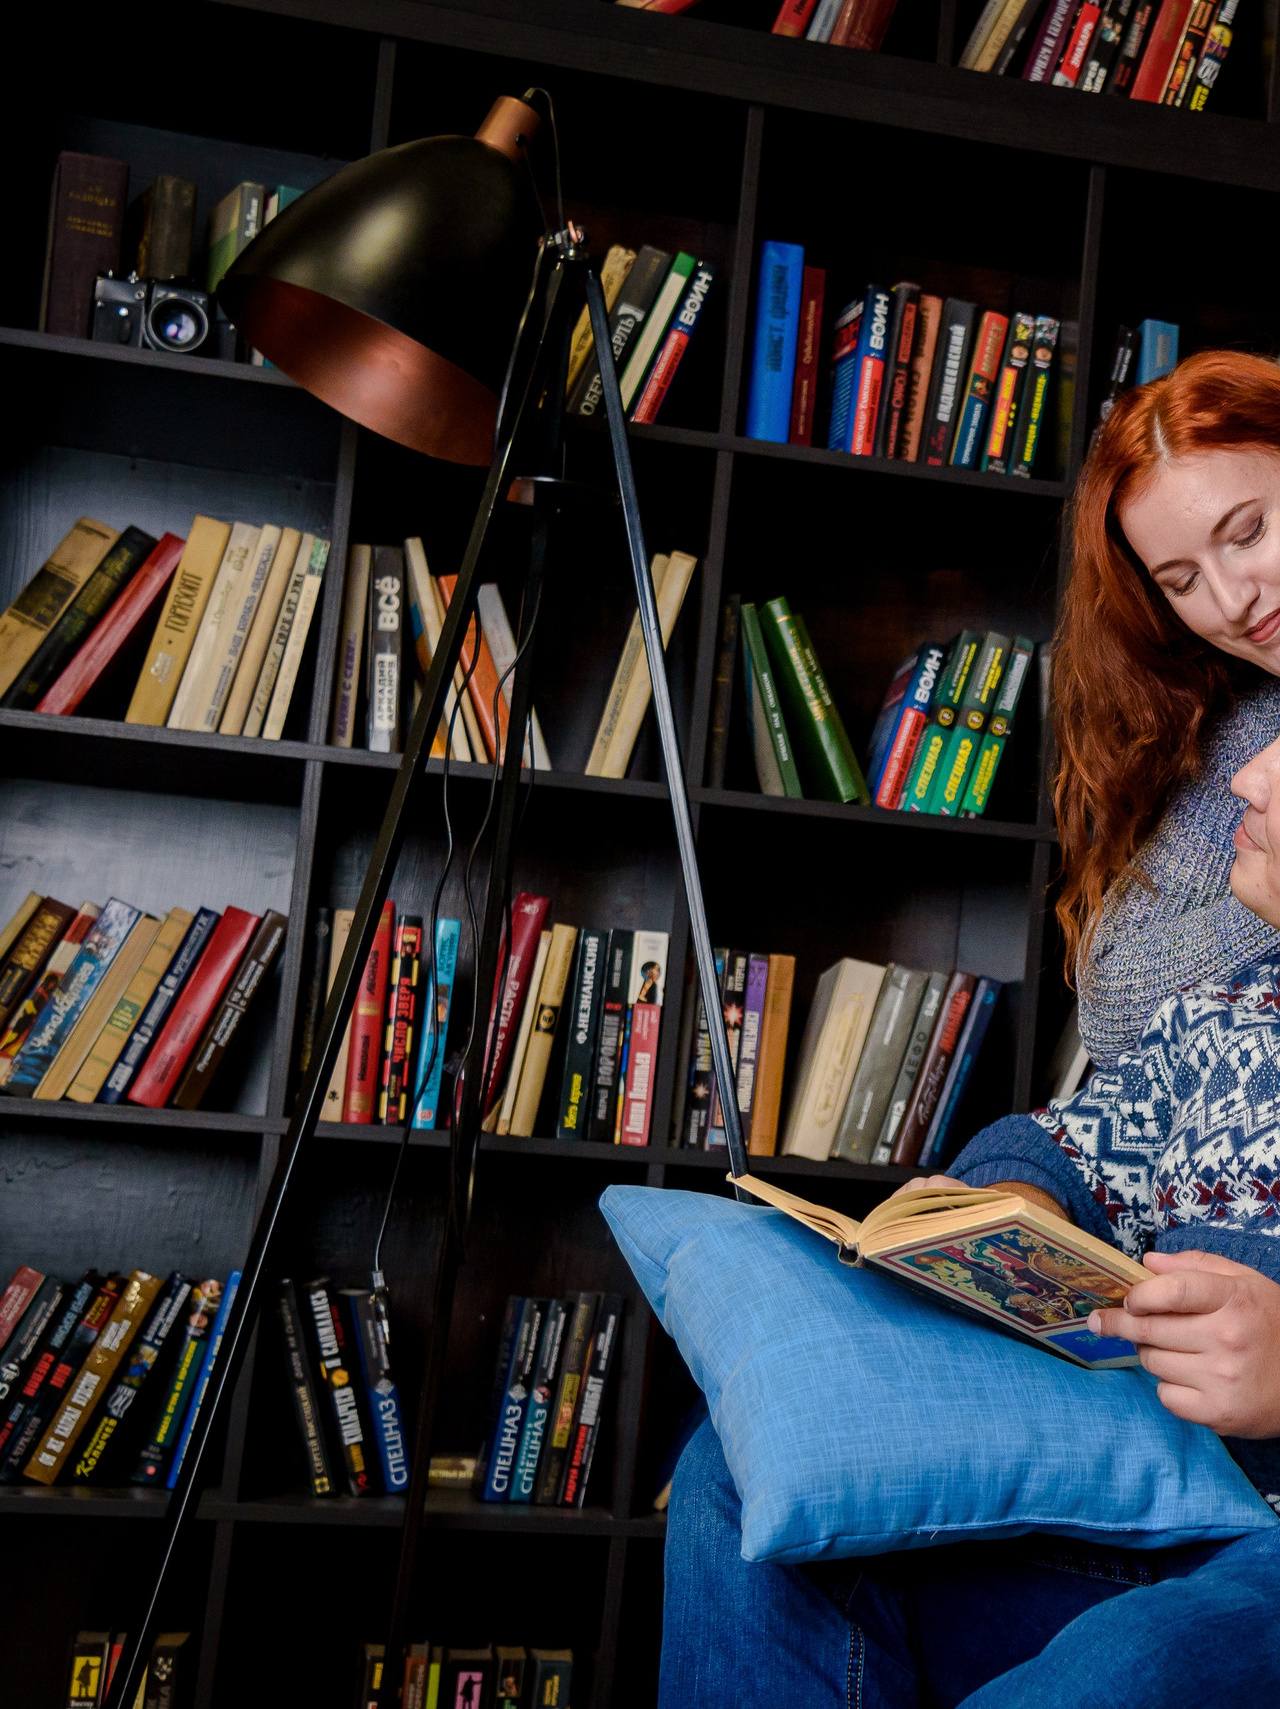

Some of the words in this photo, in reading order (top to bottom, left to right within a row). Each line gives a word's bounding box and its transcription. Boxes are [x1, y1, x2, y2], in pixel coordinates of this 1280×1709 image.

[678, 270, 714, 327] ВОИН
[869, 292, 890, 351] ВОИН
[164, 569, 203, 635] ГОРИЗОНТ
[376, 659, 385, 723] АРКАДИЙ
[386, 661, 396, 722] АРКАНОВ
[914, 648, 943, 703] ВОИН
[914, 735, 943, 799] СПЕЦНАЗ
[943, 738, 973, 803] СПЕЦНАЗ
[397, 976, 412, 1019] ЗВЕРЯ
[500, 980, 521, 1029] РАСТИ
[576, 936, 599, 1044] Ф.НЕЗНАНСКИЙ
[394, 1020, 405, 1065] ЧИСЛО
[597, 1012, 620, 1087] ВОРОНИН
[378, 1397, 408, 1486] СПЕЦНАЗ
[491, 1403, 523, 1493] СПЕЦНАЗ
[520, 1407, 548, 1494] СПЕЦНАЗ
